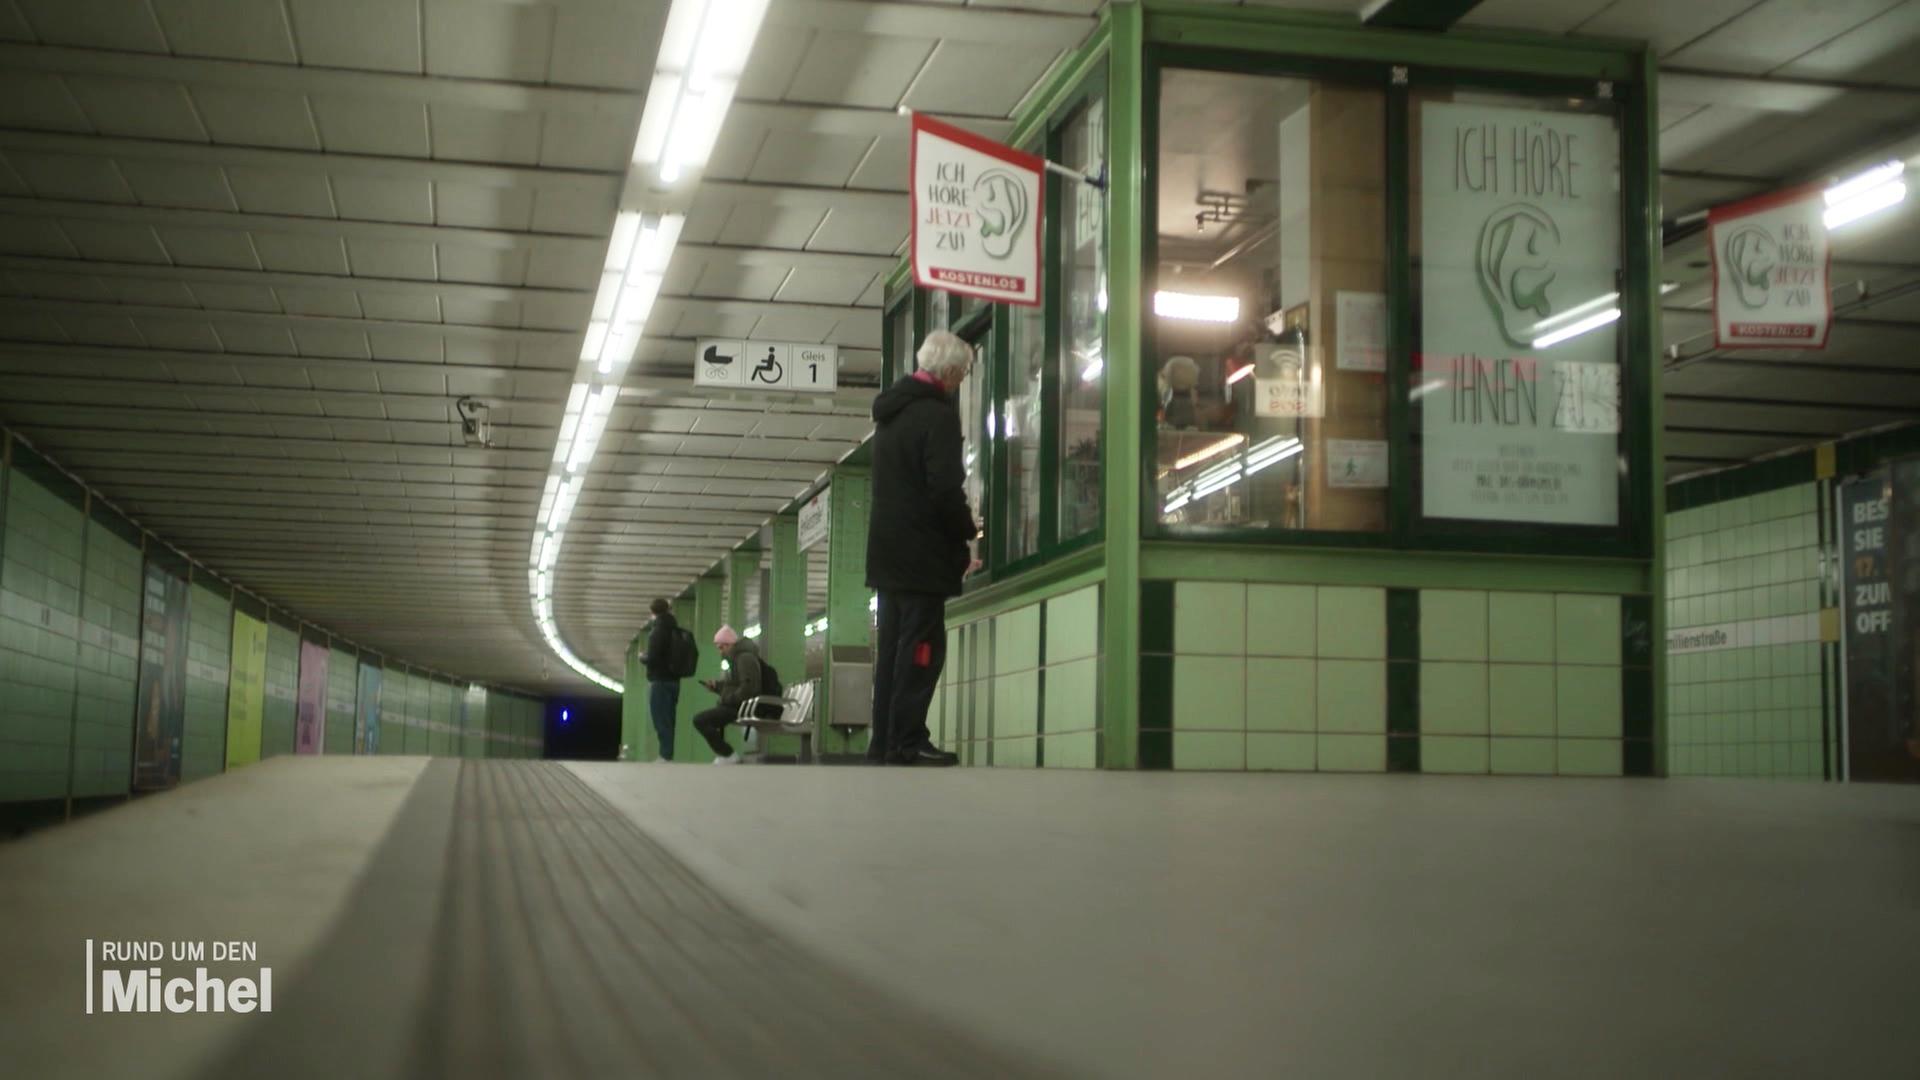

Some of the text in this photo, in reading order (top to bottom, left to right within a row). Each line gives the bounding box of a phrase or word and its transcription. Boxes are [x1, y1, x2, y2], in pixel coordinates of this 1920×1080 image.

[1455, 121, 1581, 199] ICH HÖRE
[937, 162, 965, 184] ICH
[926, 207, 972, 228] JETZT
[938, 271, 1018, 290] KOSTENLOS
[1739, 325, 1809, 337] KOSTENLOS
[801, 350, 825, 362] Gleis
[808, 363, 817, 383] 1
[1452, 353, 1537, 427] IHNEN
[1855, 527, 1883, 552] SIE
[1856, 609, 1891, 634] OFF
